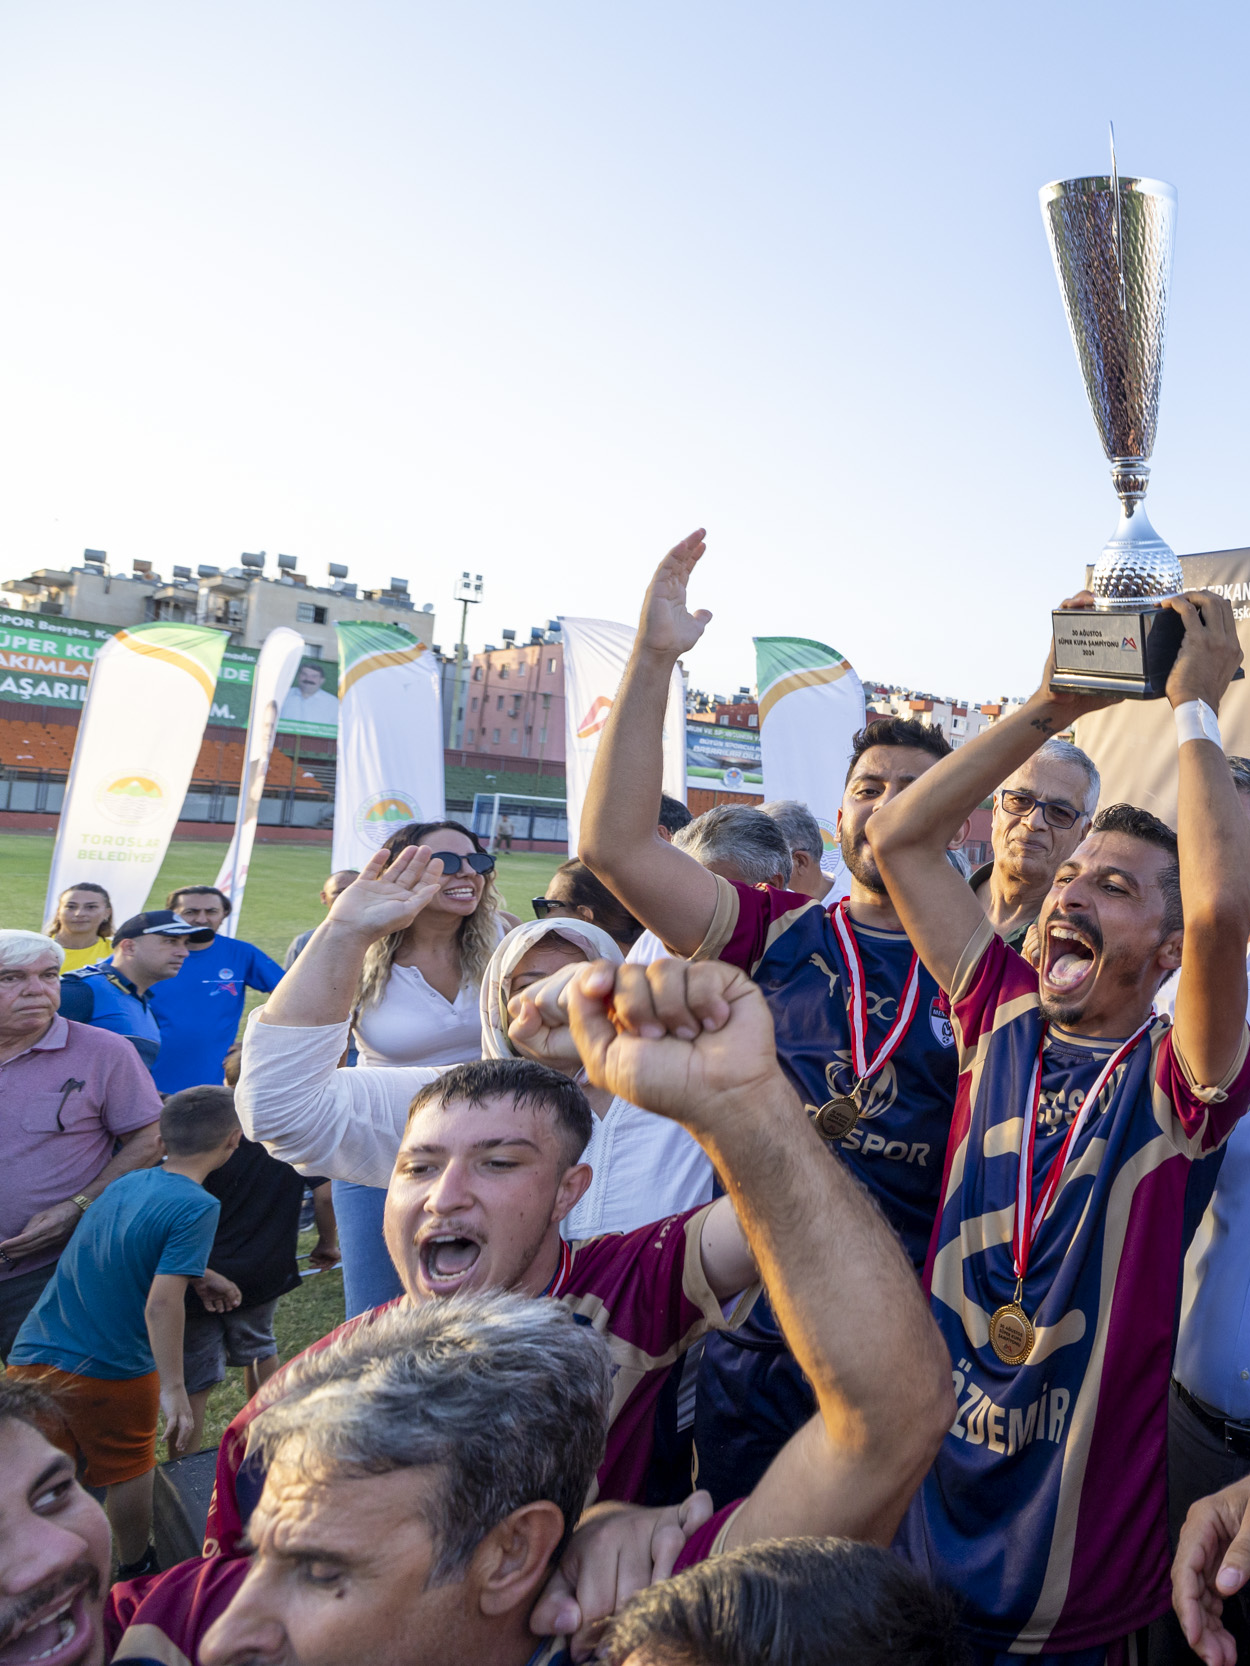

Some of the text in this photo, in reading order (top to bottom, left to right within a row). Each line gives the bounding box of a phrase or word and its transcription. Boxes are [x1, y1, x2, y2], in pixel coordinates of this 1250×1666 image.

[1079, 629, 1102, 637] AĞUSTOS
[1058, 637, 1072, 645] SÜPER
[1088, 639, 1119, 648] ŞAMPİYONU
[841, 1128, 931, 1167] SPOR
